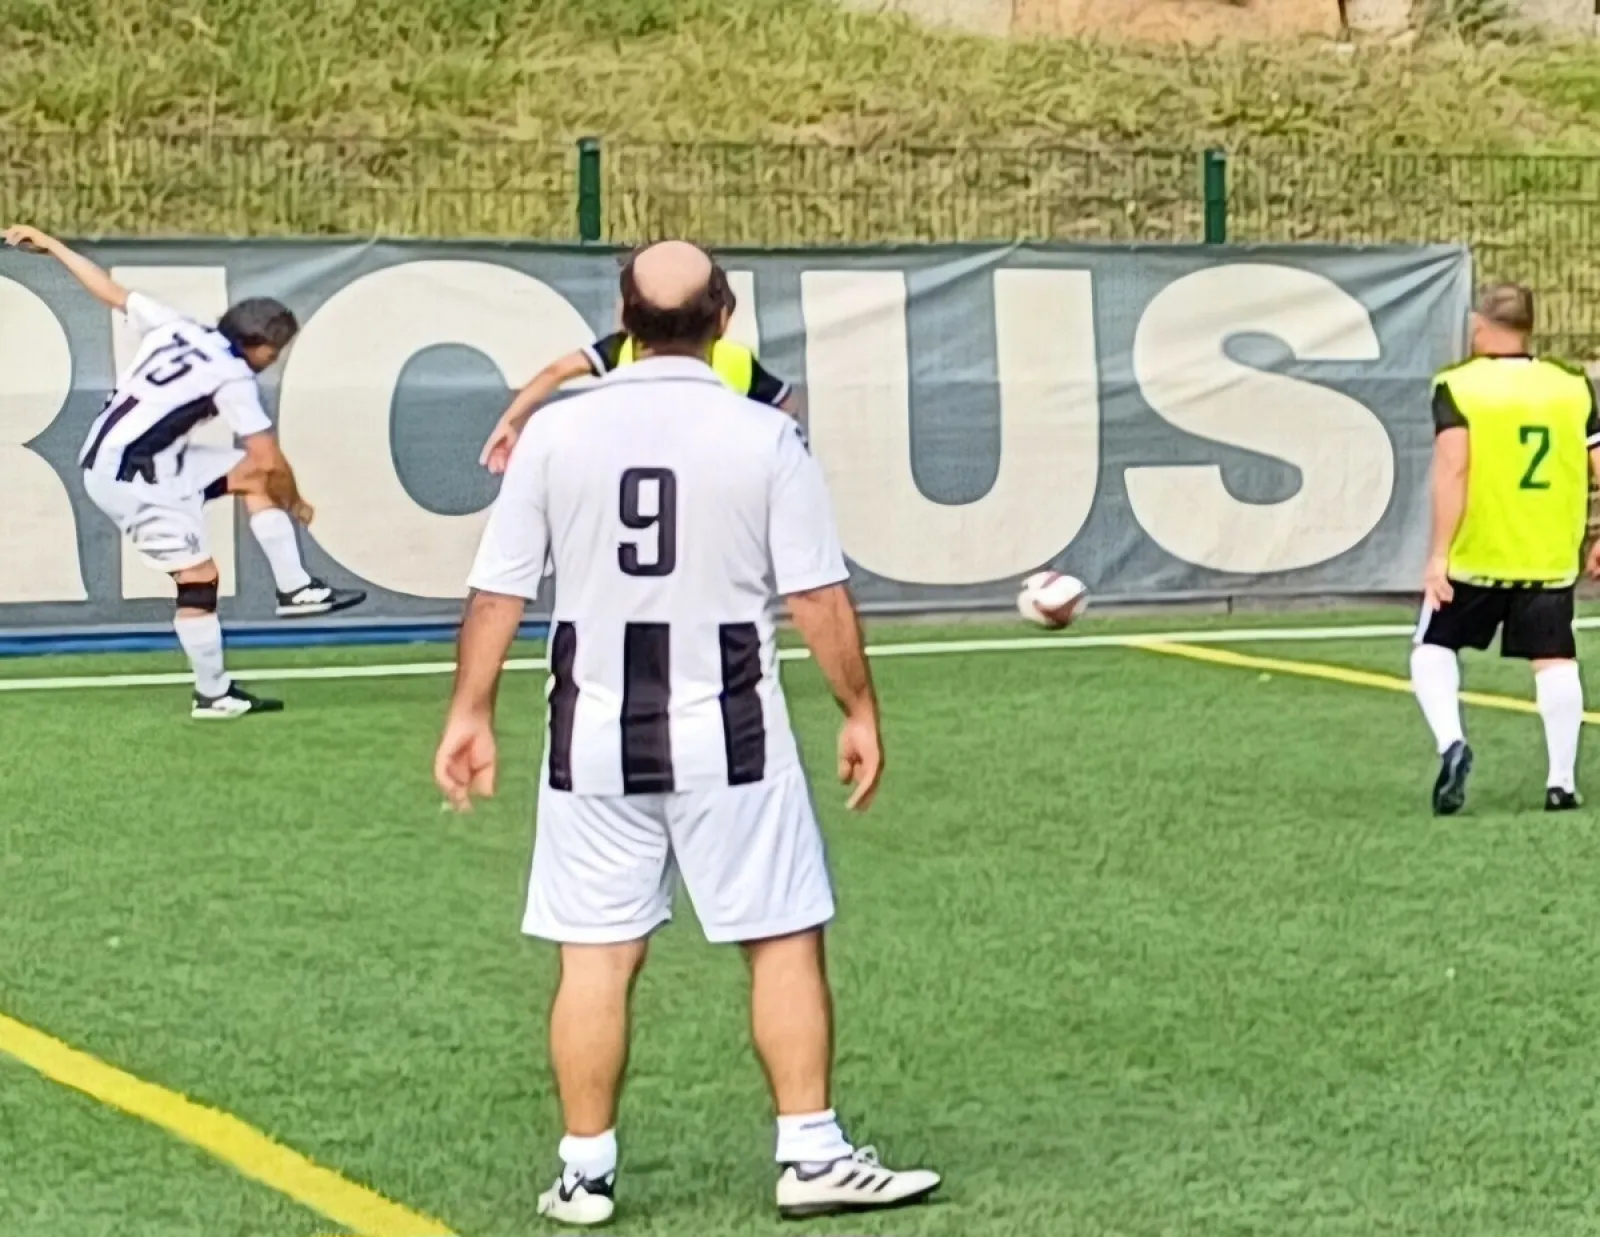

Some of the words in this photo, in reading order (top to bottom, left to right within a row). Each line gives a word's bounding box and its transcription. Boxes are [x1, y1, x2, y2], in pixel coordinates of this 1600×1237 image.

[0, 261, 1394, 603] CUS
[1519, 425, 1550, 489] 2
[618, 467, 677, 577] 9
